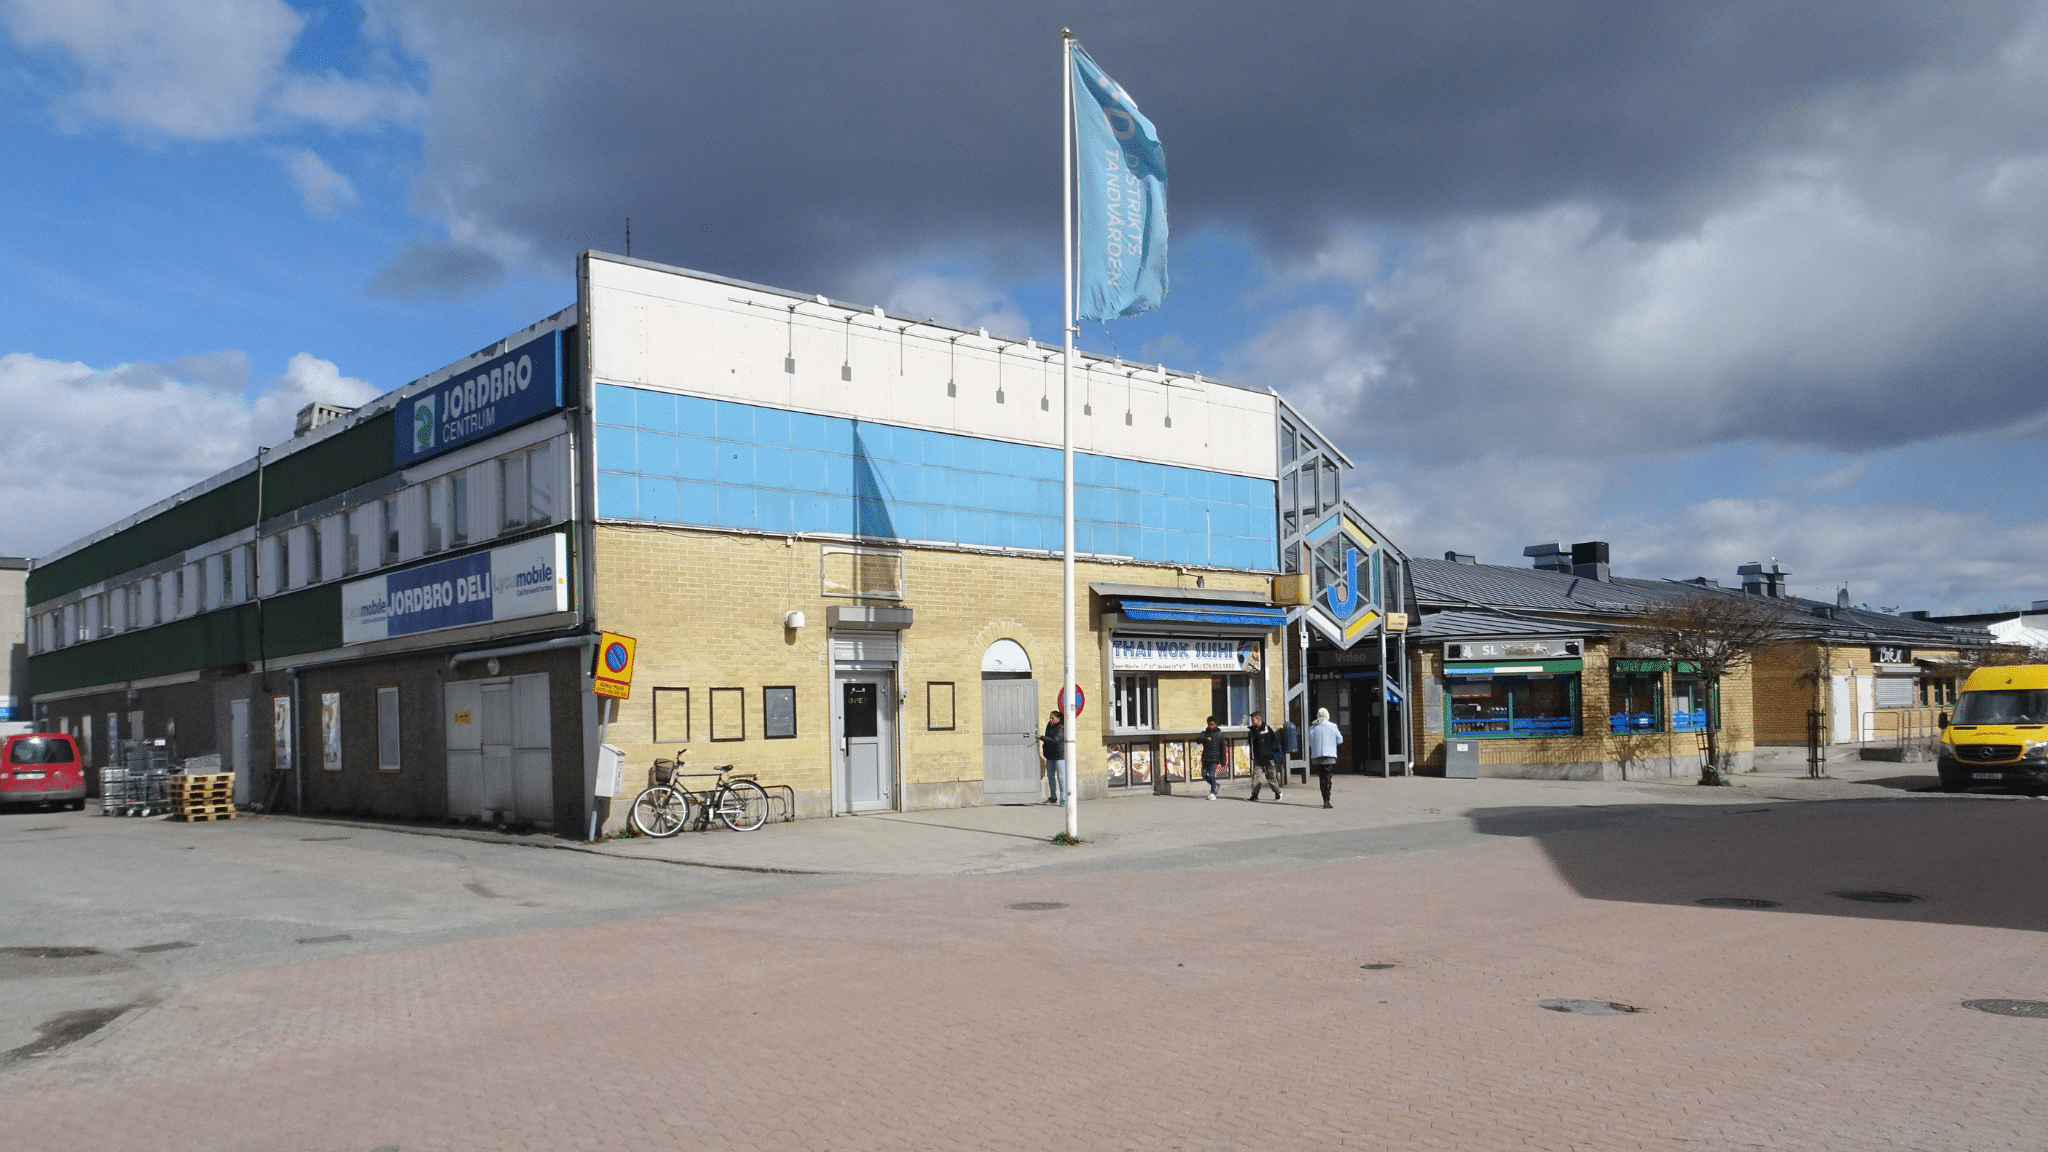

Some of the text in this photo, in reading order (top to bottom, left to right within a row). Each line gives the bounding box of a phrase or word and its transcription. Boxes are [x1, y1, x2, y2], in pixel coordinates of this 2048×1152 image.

[1105, 149, 1126, 287] TANDVÅRDEN
[1124, 153, 1142, 256] DISTRIKTS
[443, 354, 532, 423] JORDBRO
[442, 406, 496, 444] CENTRUM
[387, 572, 491, 618] JORDBRO DELI
[1113, 640, 1233, 659] THAI WOK SUSHI
[1335, 651, 1367, 663] Video
[1482, 645, 1498, 656] SL
